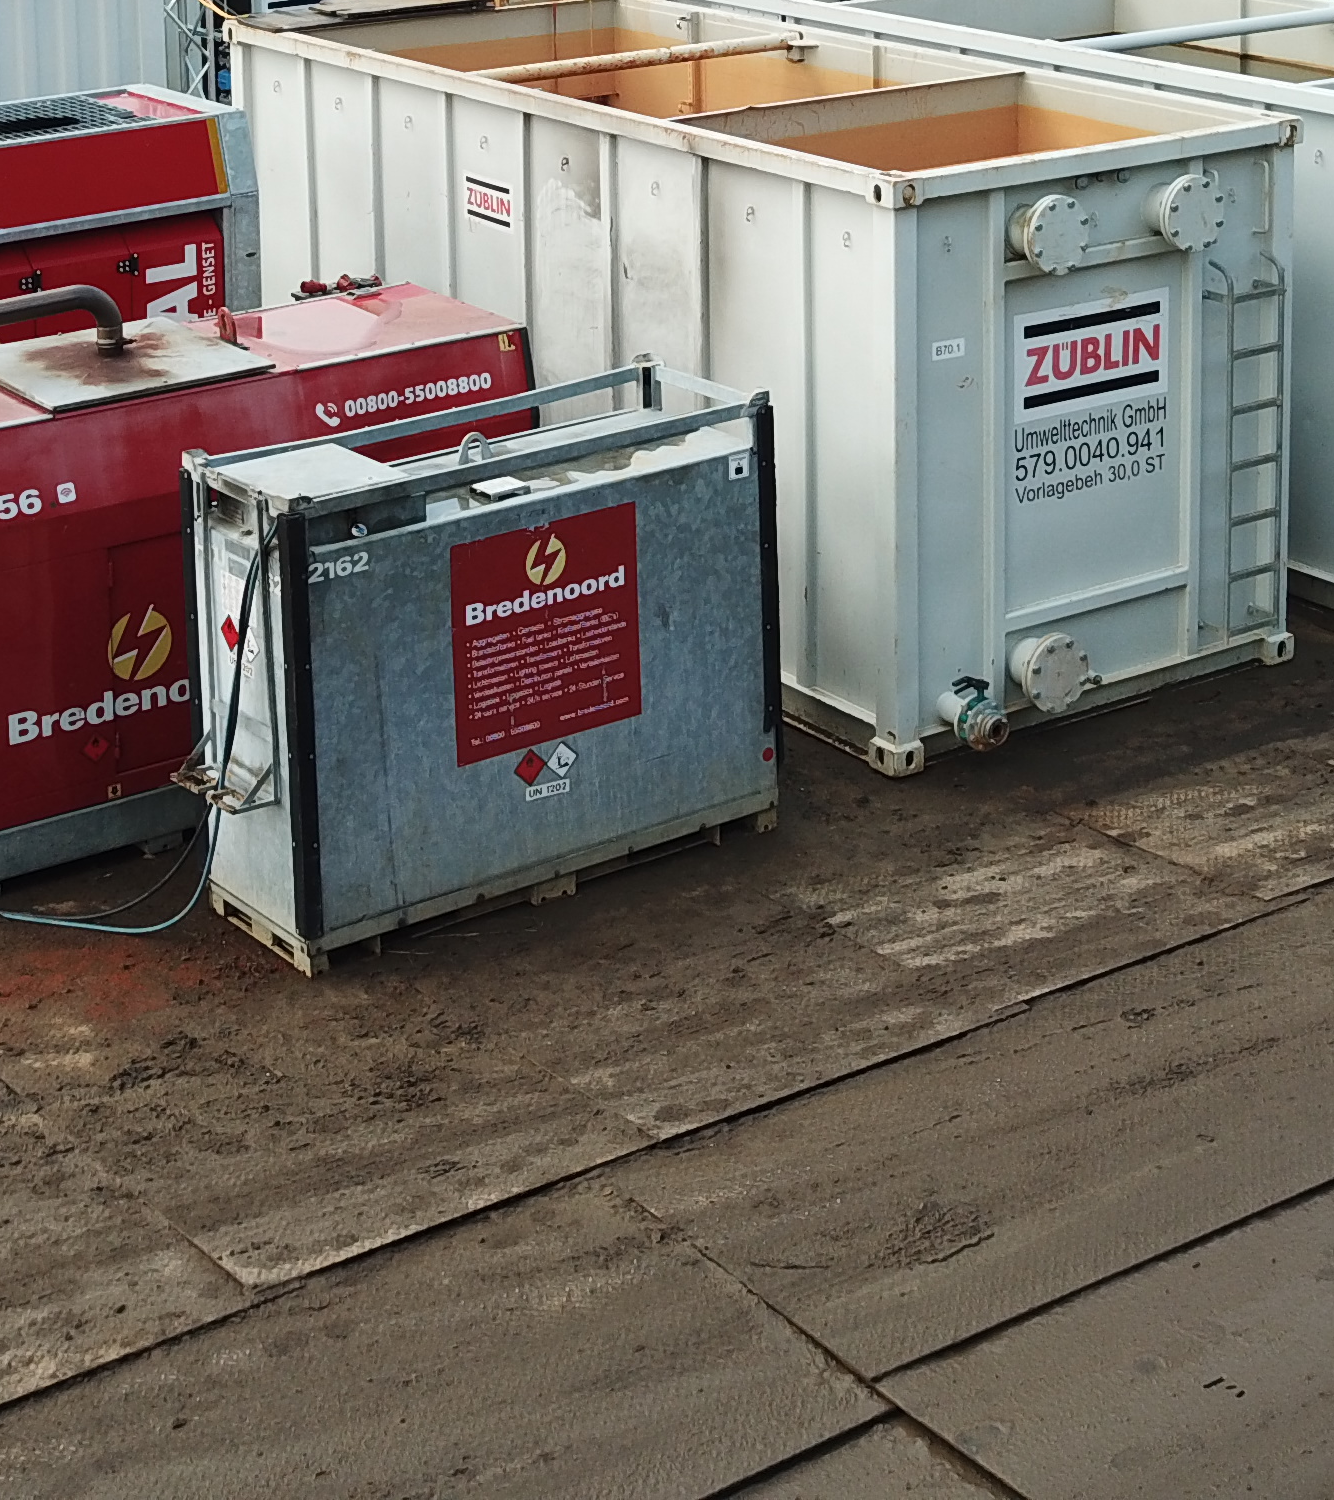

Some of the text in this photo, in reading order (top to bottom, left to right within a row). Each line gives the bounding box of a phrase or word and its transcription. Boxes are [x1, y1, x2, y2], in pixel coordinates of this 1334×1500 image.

[201, 242, 216, 296] GENSET
[1024, 323, 1161, 388] ZÜBLIN
[344, 372, 492, 418] 00800-55008800
[1014, 396, 1167, 453] Umwelttechnik GmbH
[1015, 426, 1165, 482] 579.0040.941
[1015, 453, 1166, 504] Vorlagebeh 30,0 ST
[307, 551, 370, 584] 2162
[465, 565, 626, 627] Bredenoord
[528, 787, 543, 798] UN
